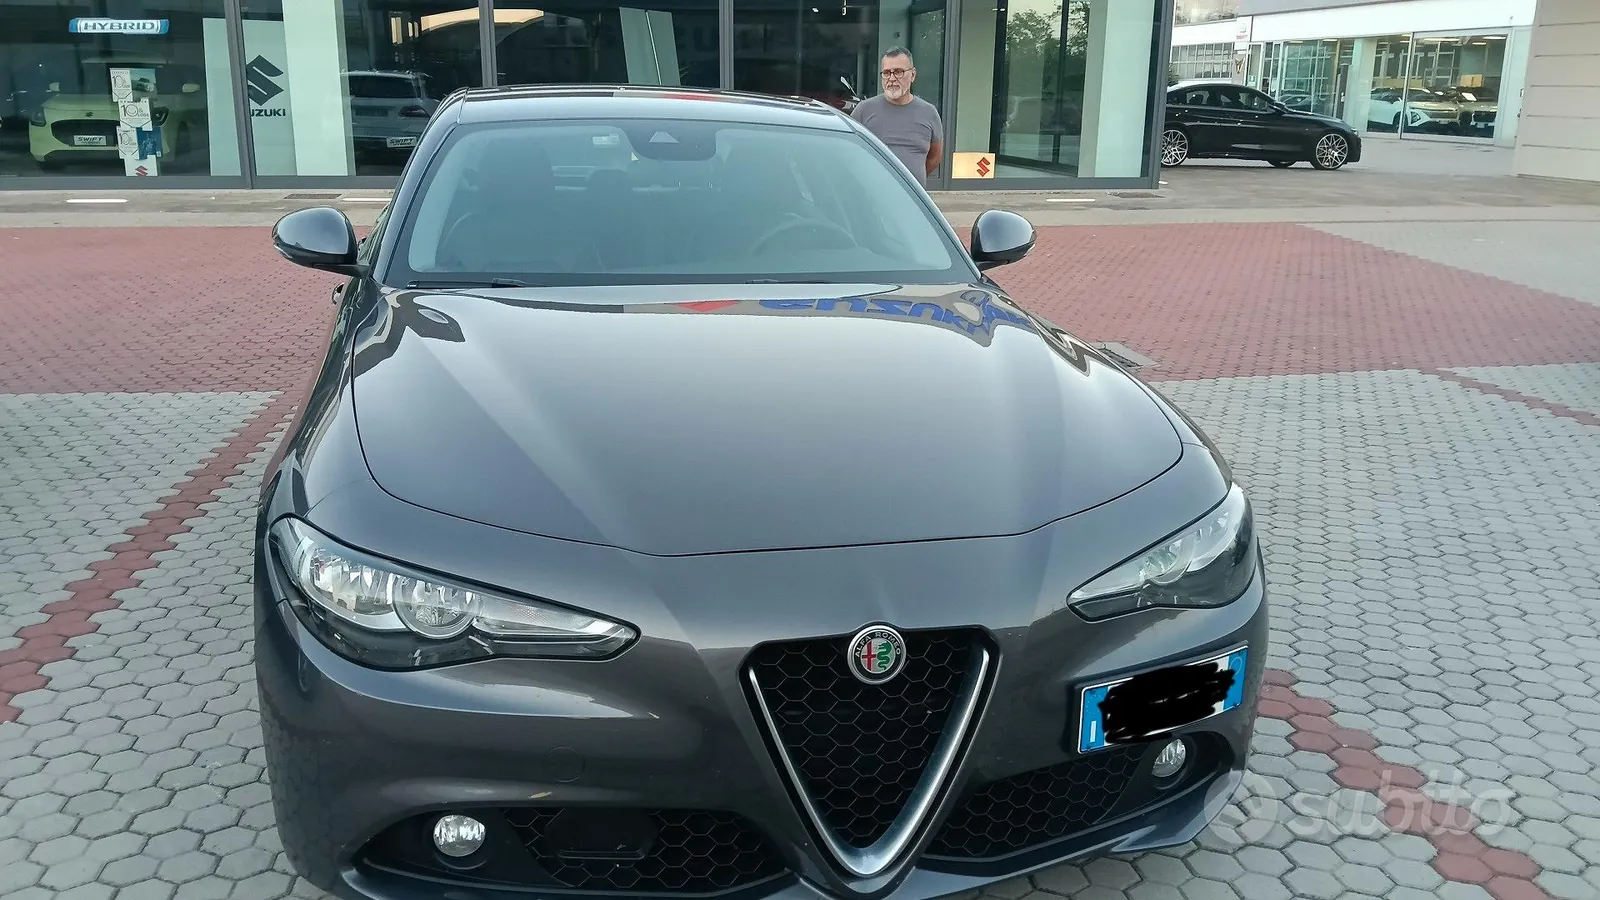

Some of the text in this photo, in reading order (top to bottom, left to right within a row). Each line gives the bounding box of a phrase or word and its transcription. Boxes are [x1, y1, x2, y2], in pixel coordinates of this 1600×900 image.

[83, 22, 155, 30] HYBRID
[250, 108, 286, 117] UZUKI
[854, 631, 901, 658] ALFA ROMEO
